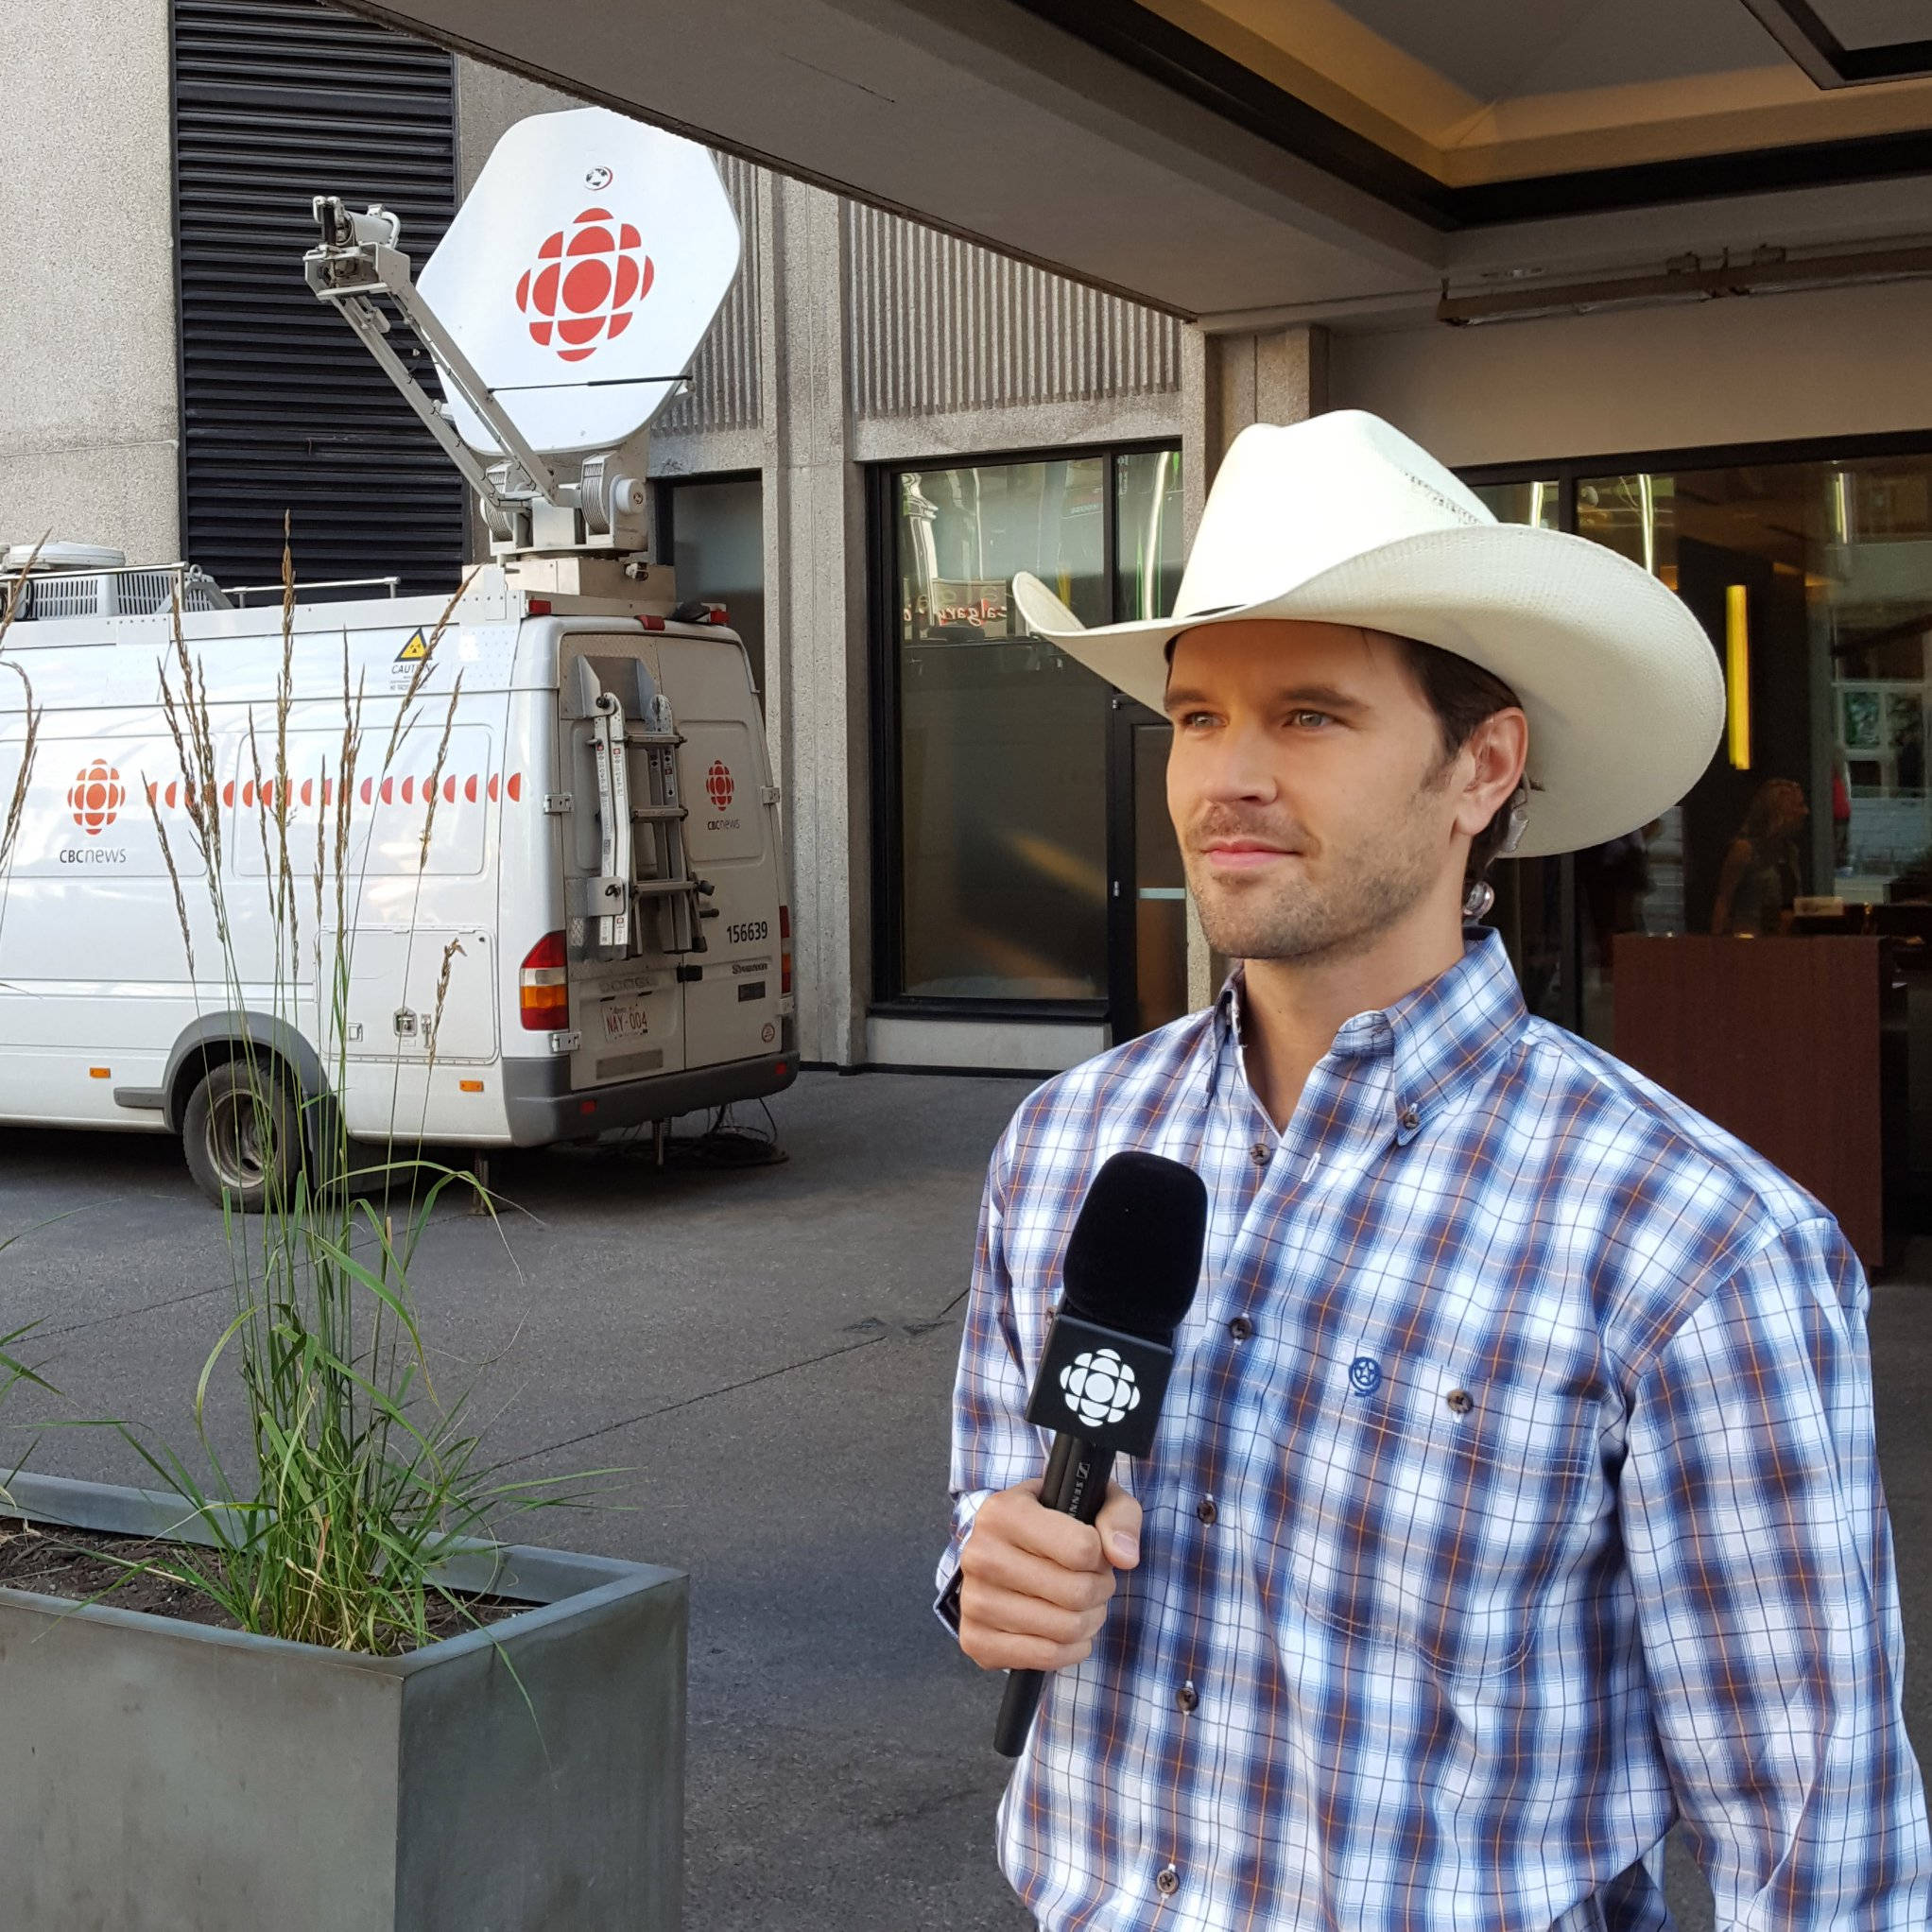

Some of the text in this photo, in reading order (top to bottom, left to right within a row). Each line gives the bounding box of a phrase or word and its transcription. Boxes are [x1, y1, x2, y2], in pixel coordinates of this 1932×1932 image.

[391, 664, 432, 675] CAUTN
[727, 921, 768, 943] 156639
[1068, 1481, 1084, 1516] SENN
